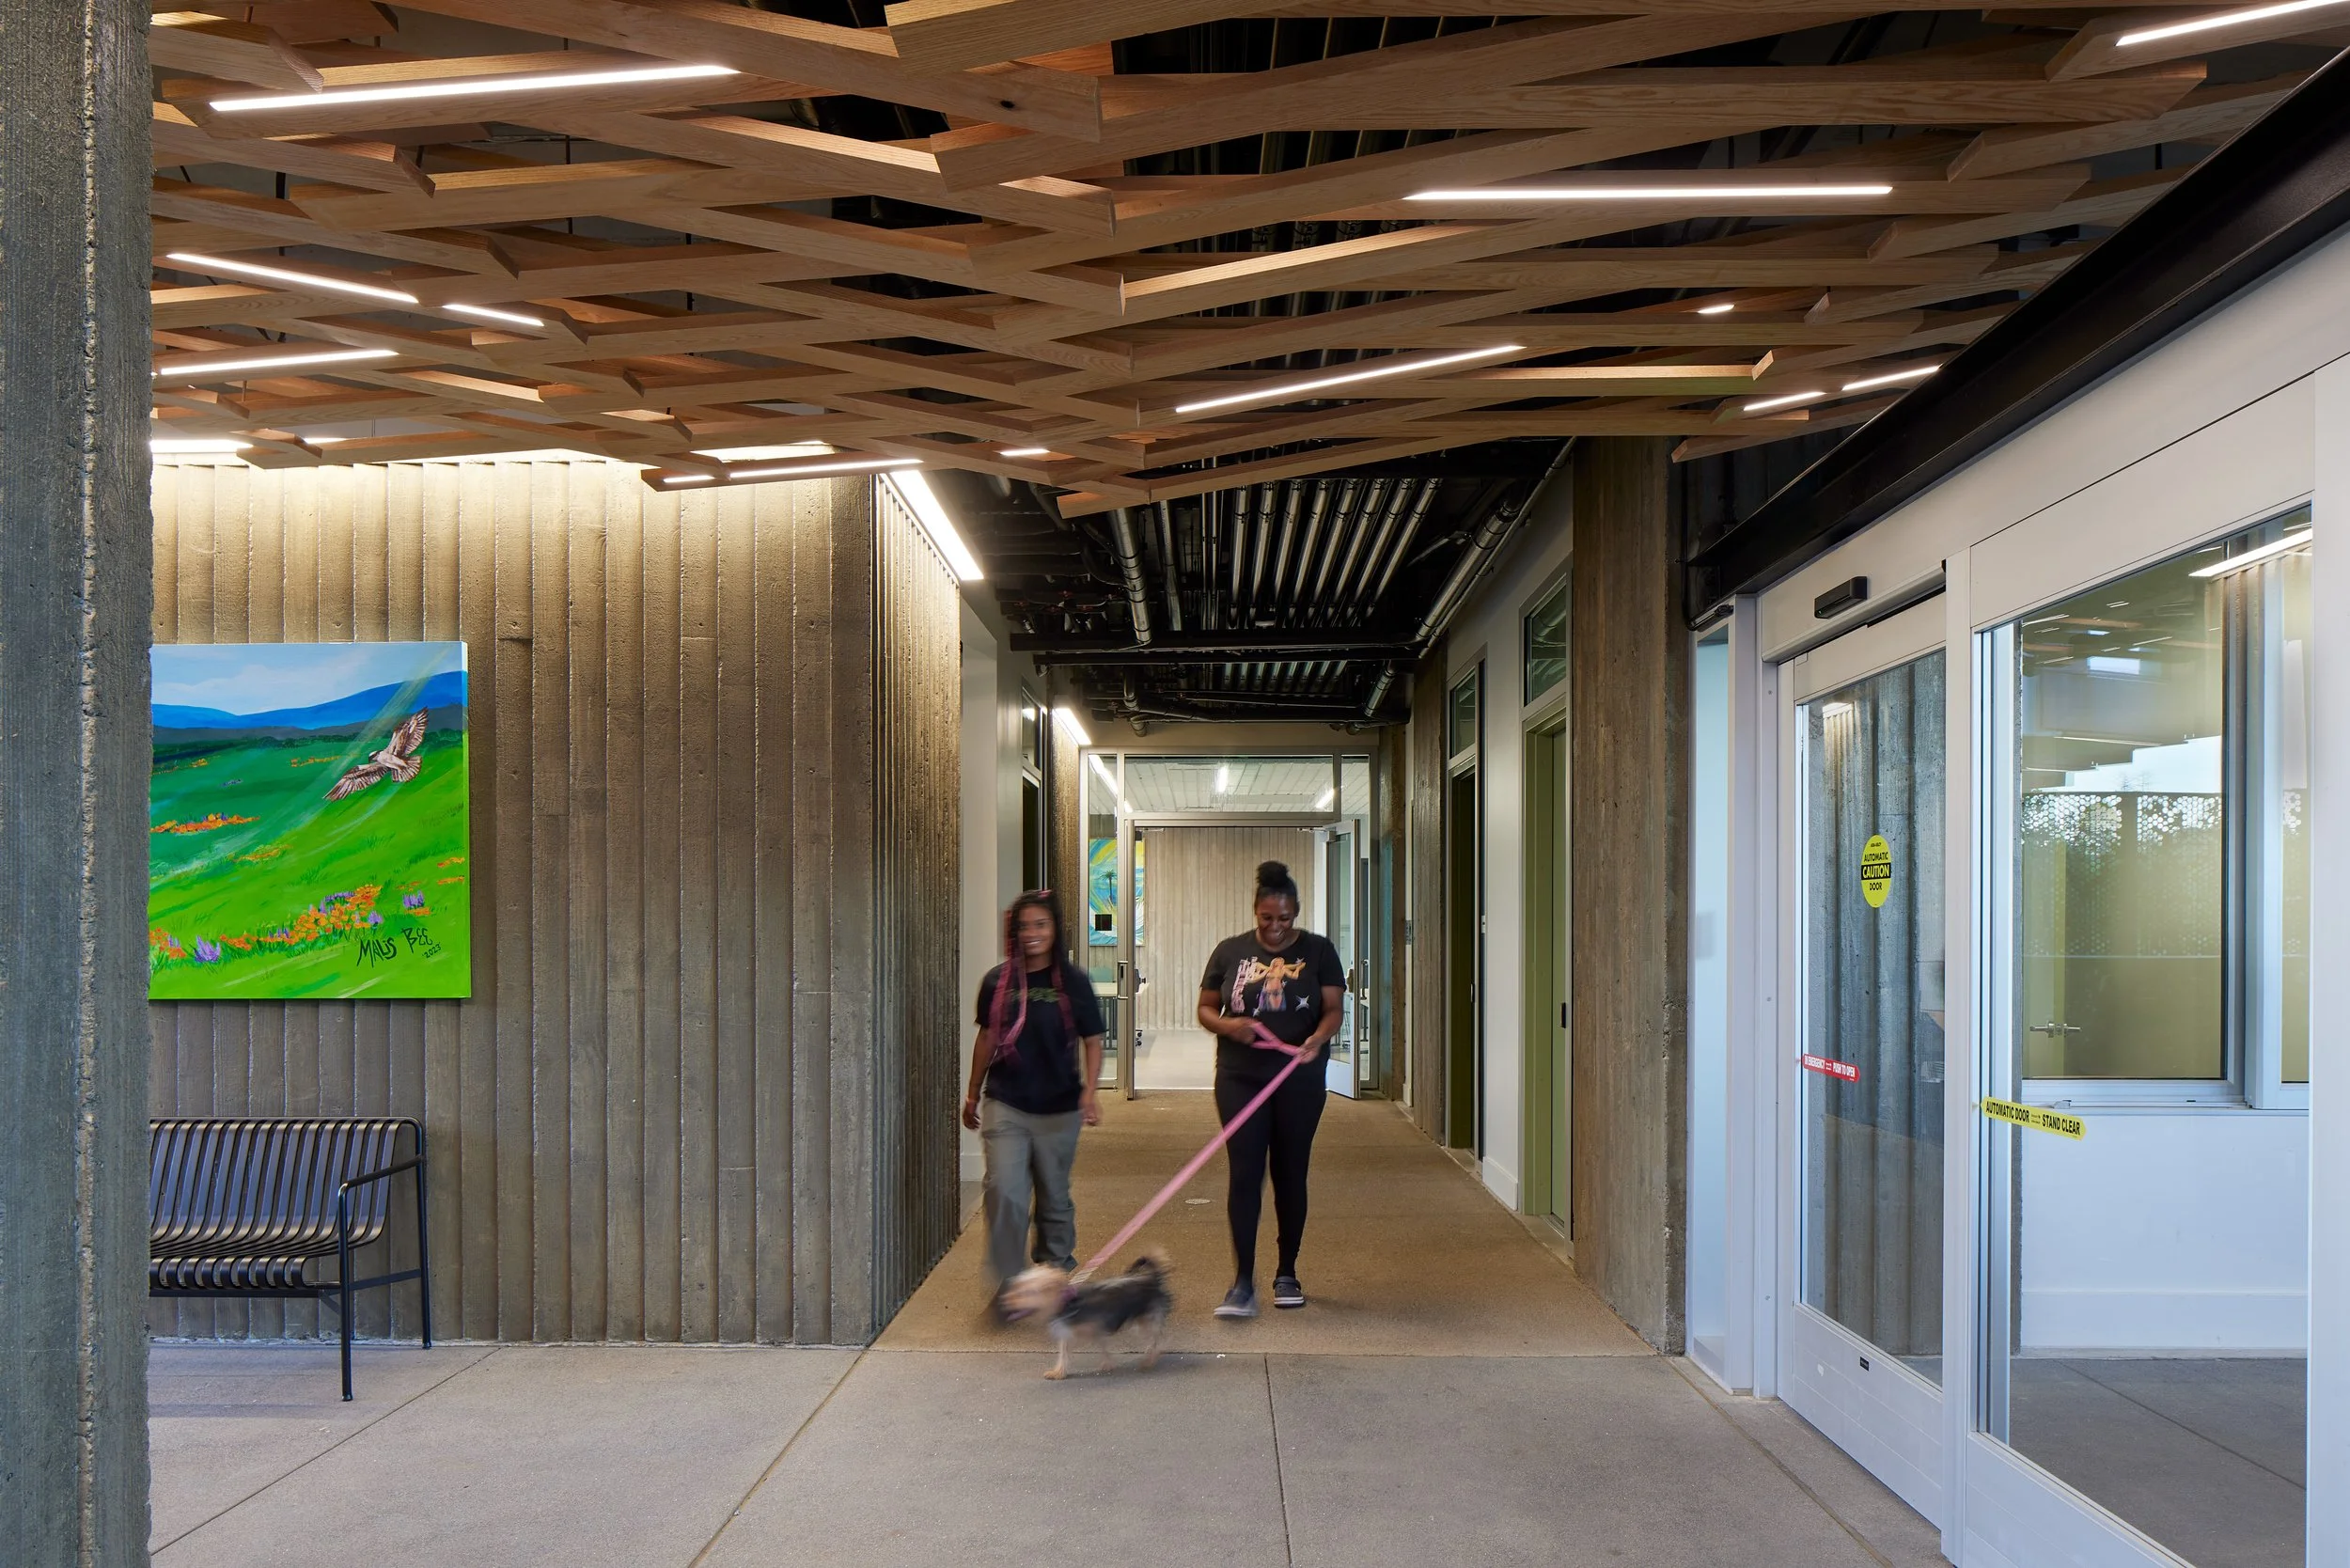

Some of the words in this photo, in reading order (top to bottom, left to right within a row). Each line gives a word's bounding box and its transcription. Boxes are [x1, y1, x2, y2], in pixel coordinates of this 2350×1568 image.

[1864, 852, 1888, 862] AUTOMATIC
[1862, 864, 1890, 879] CAUTION
[1869, 882, 1883, 891] DOOR
[1985, 1101, 2014, 1119] AUTOMATIC
[2014, 1108, 2029, 1122] DOOR
[2042, 1113, 2060, 1131] STAND
[2061, 1118, 2080, 1136] CLEAR
